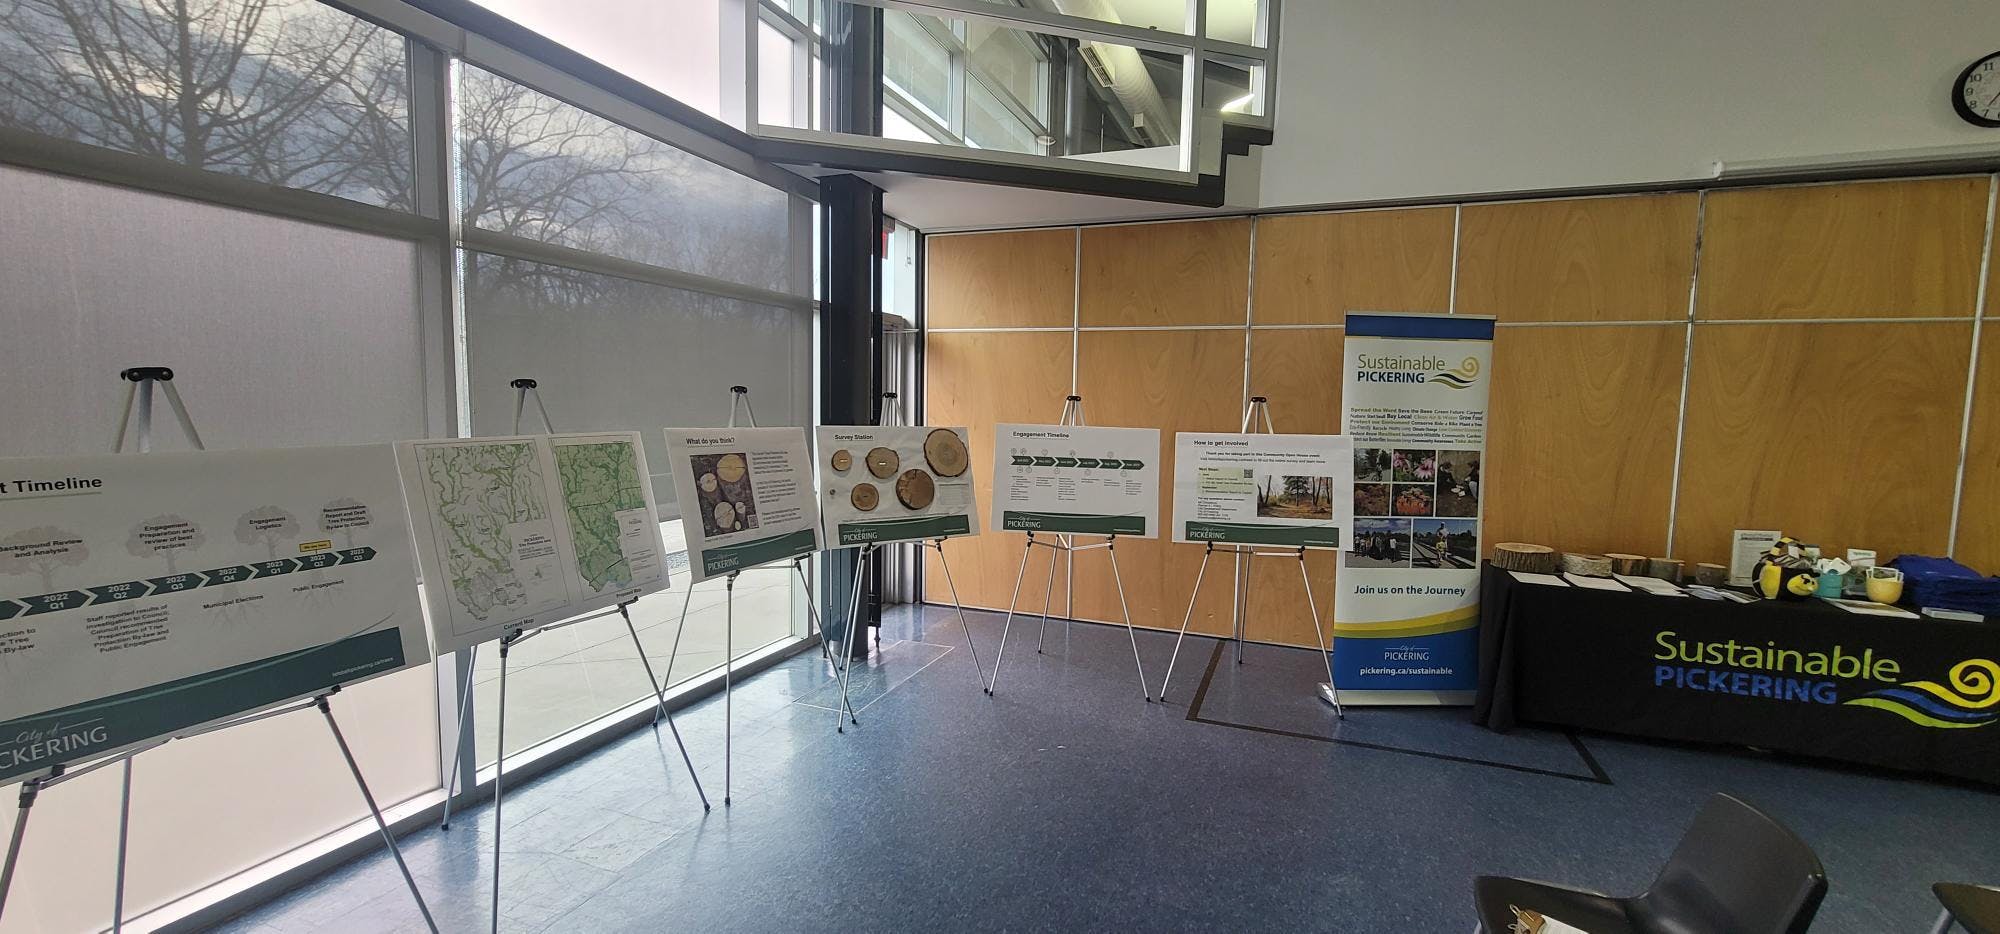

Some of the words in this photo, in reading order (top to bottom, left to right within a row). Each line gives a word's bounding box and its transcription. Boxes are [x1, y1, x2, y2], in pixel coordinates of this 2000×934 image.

[1984, 62, 1994, 71] 11
[1970, 74, 1982, 82] 10
[1966, 88, 1973, 96] 9
[1970, 100, 1976, 109] 8
[1982, 109, 1989, 117] 7
[1358, 354, 1446, 370] Sustainable
[1357, 371, 1425, 383] PICKERING
[12, 477, 102, 492] Timeline
[250, 516, 286, 525] Engagement
[1008, 520, 1040, 528] PICKERING
[144, 522, 188, 531] Engagement
[139, 530, 180, 538] Preparation
[844, 532, 878, 542] PICKERING
[1190, 531, 1225, 540] PICKERING
[34, 547, 69, 556] Analysis
[707, 556, 739, 572] PICKERING
[108, 584, 131, 592] 2022
[311, 579, 344, 590] Engagement
[1354, 585, 1375, 594] Join
[1406, 585, 1423, 594] the
[1424, 586, 1466, 597] Journey
[44, 593, 69, 602] 2022
[203, 600, 234, 609] Municipal
[235, 595, 264, 604] Elections
[50, 602, 64, 610] Q1
[106, 610, 134, 619] reported
[504, 621, 521, 630] Current
[124, 636, 166, 648] Engagement
[1384, 652, 1430, 661] PICKERING
[1654, 630, 1900, 683] Sustainable
[1360, 667, 1453, 676] pickering.ca/sustainable
[1654, 665, 1837, 705] PICKERING
[16, 729, 42, 744] City
